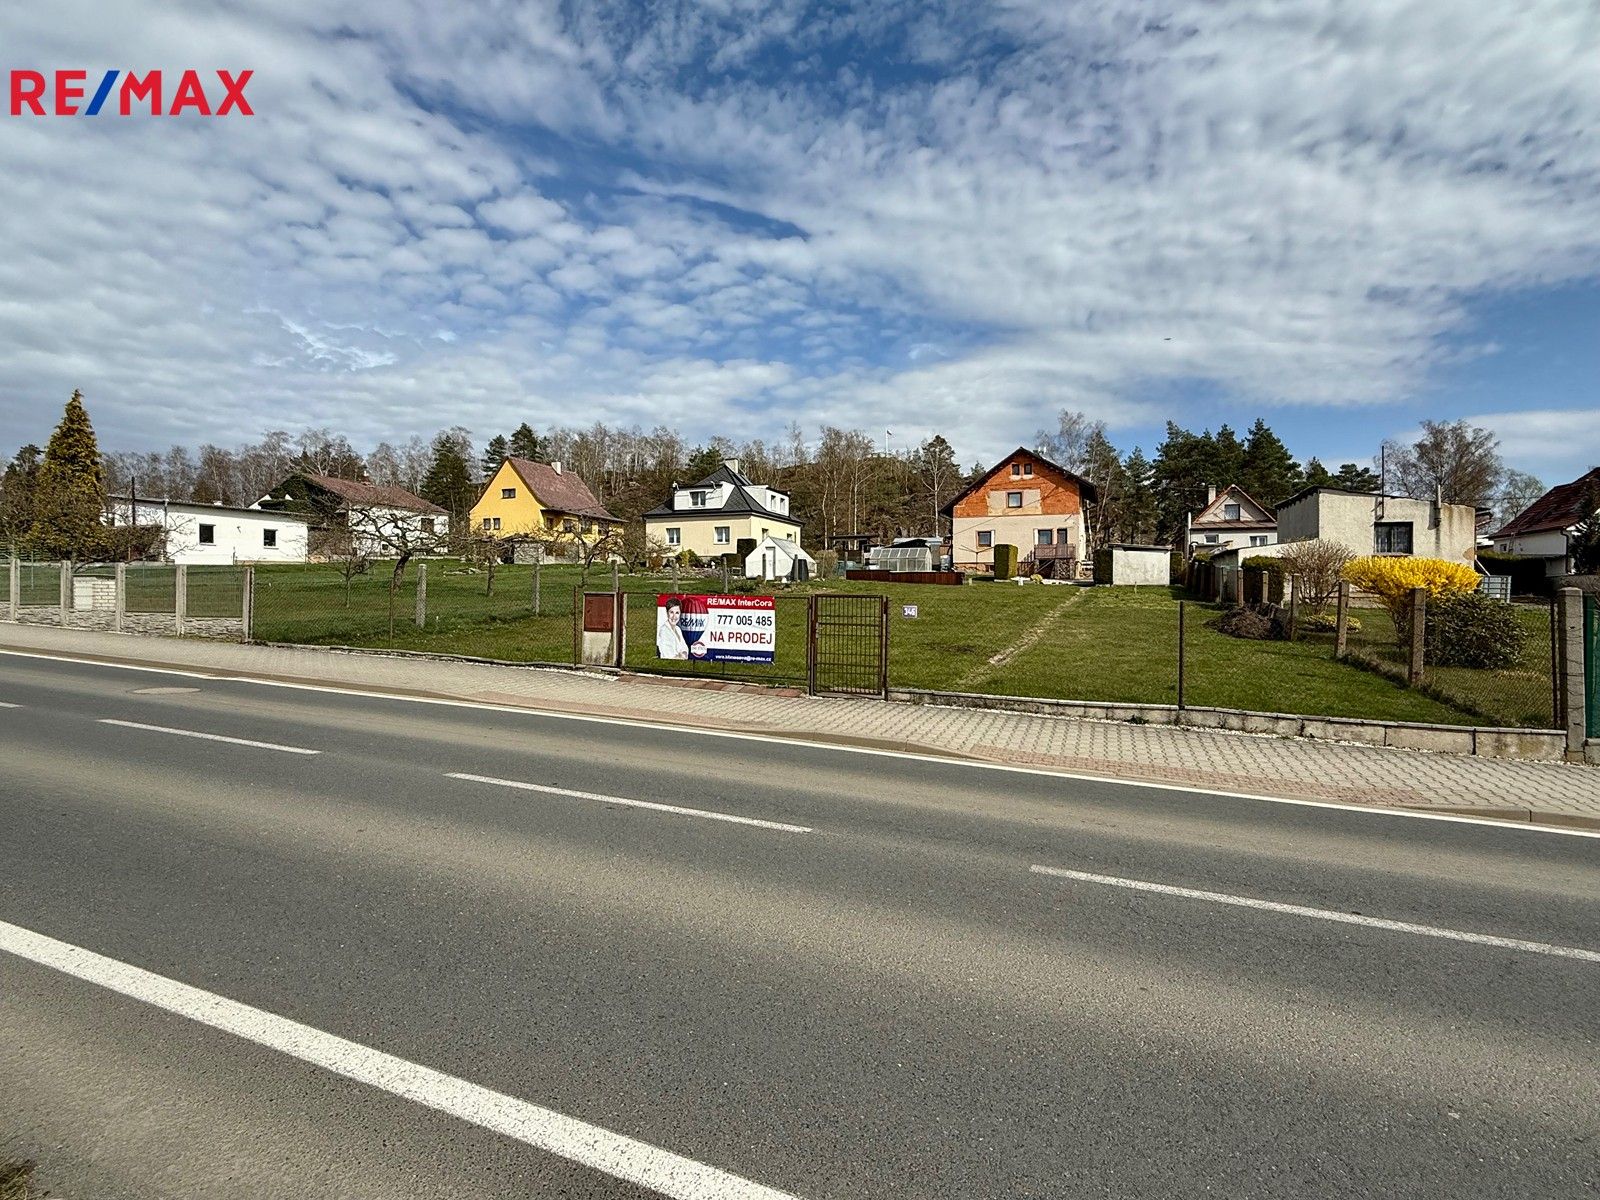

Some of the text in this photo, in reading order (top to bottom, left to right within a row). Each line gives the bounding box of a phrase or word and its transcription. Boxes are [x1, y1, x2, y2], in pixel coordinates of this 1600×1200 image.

[707, 597, 772, 607] RE/MAX InterCora
[680, 617, 706, 627] RE/MAX
[717, 614, 773, 627] 777 005 485
[710, 631, 772, 645] NA PRODEJ
